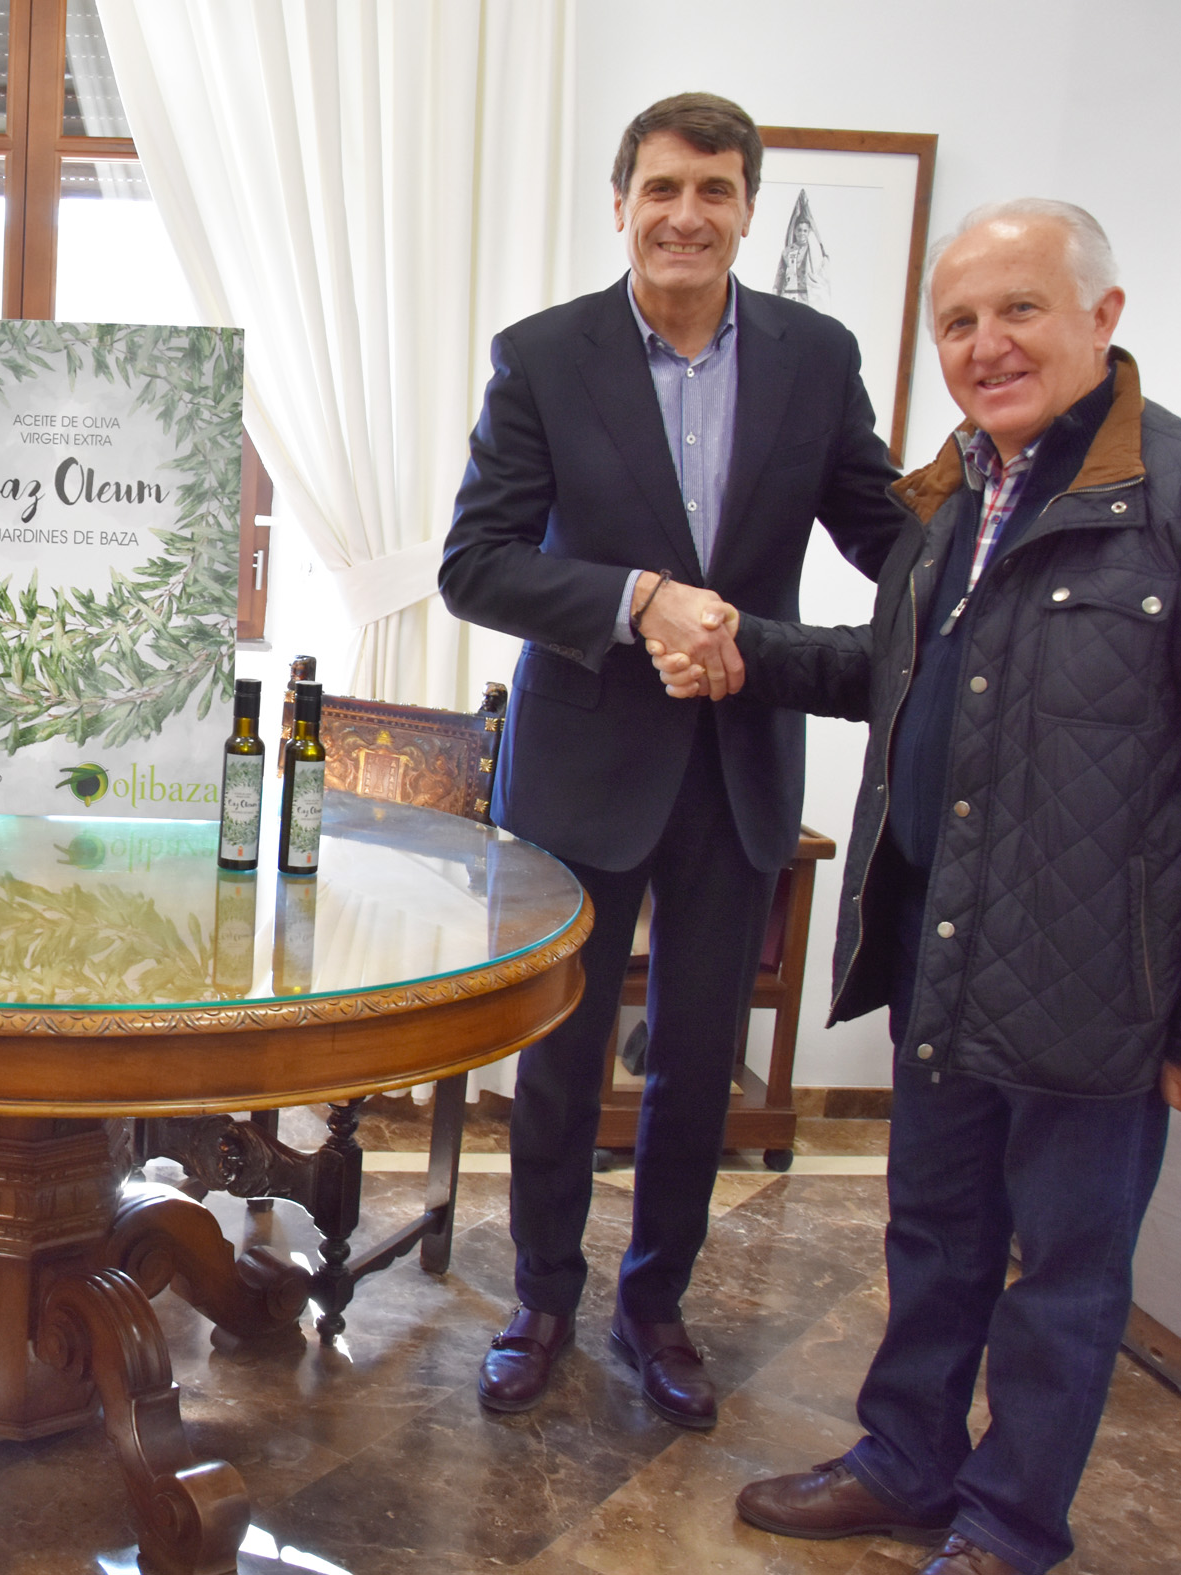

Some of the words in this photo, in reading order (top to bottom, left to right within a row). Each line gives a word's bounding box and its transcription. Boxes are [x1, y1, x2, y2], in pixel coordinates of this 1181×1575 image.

[13, 414, 57, 428] ACEITE
[61, 415, 78, 428] DE
[82, 415, 121, 429] OLIVA
[20, 432, 69, 446] VIRGEN
[74, 433, 113, 447] EXTRA
[54, 456, 171, 506] Oleum
[73, 530, 94, 546] DE
[100, 531, 139, 547] BAZA
[112, 762, 220, 809] olibaza
